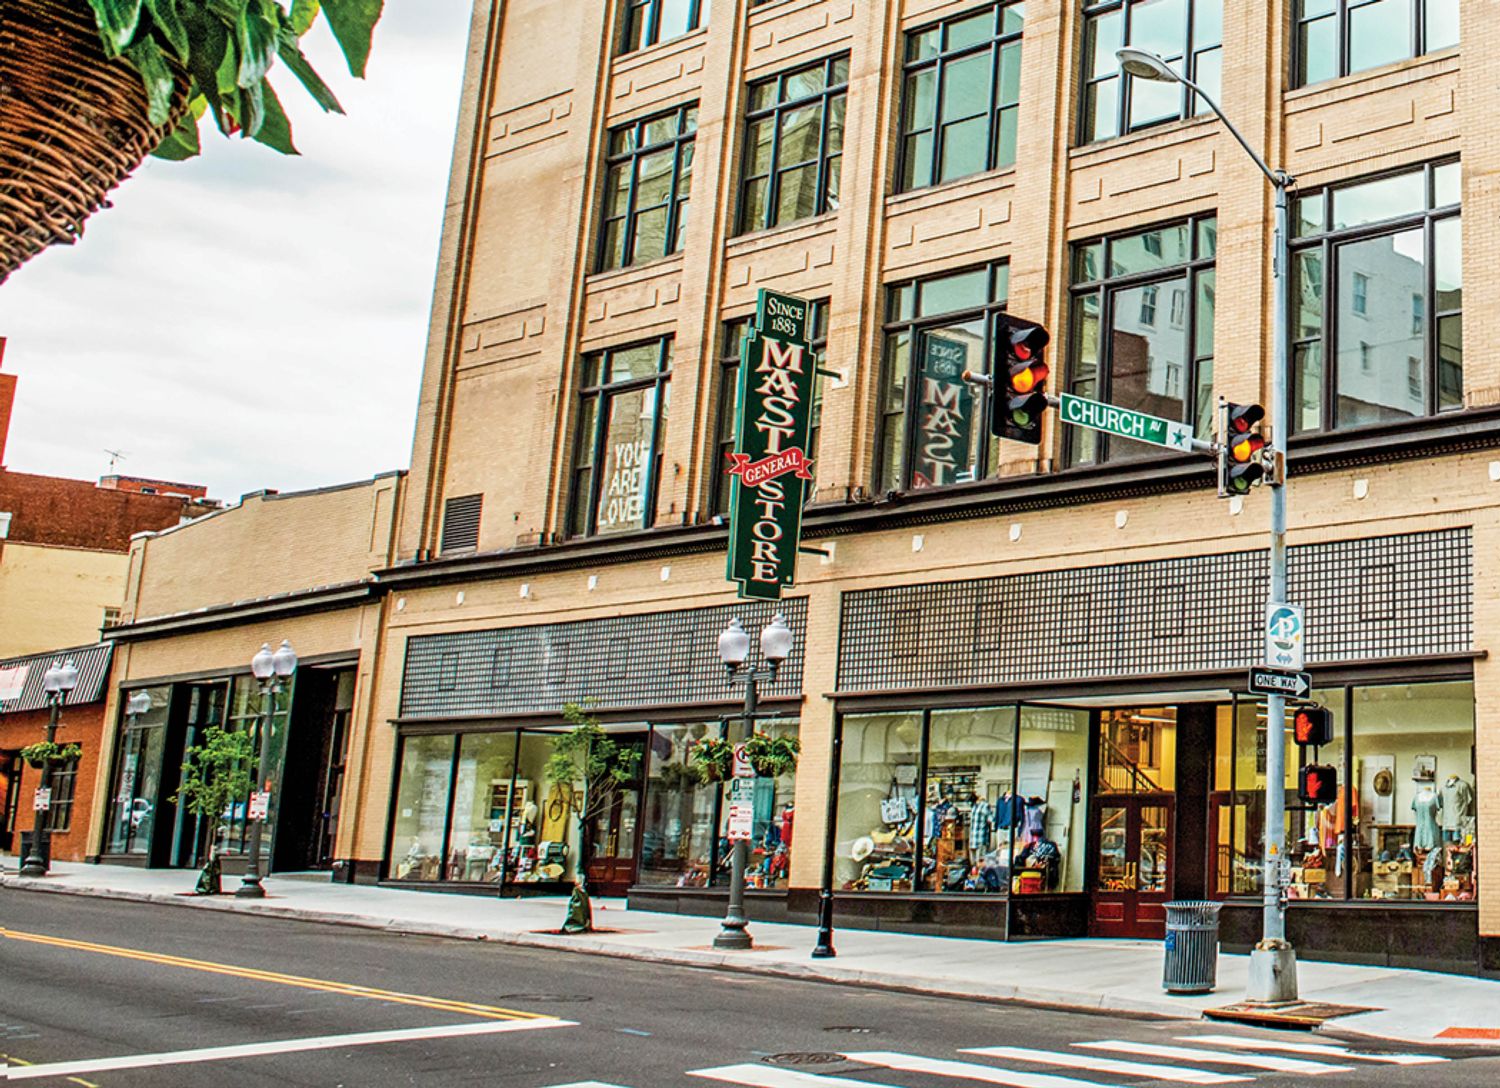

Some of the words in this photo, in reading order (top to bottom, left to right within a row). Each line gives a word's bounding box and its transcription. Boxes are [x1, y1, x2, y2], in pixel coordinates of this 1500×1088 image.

[767, 297, 804, 321] SINCE
[770, 317, 797, 338] 1883
[753, 335, 805, 456] MAST
[1068, 399, 1145, 437] CHURCH
[1149, 421, 1162, 432] AV
[615, 441, 645, 469] YOU
[745, 452, 800, 483] GENERAL
[609, 467, 642, 496] ARE
[750, 479, 785, 583] STORE
[1278, 617, 1295, 641] P
[1257, 674, 1276, 686] ONE
[1281, 678, 1297, 689] WAY
